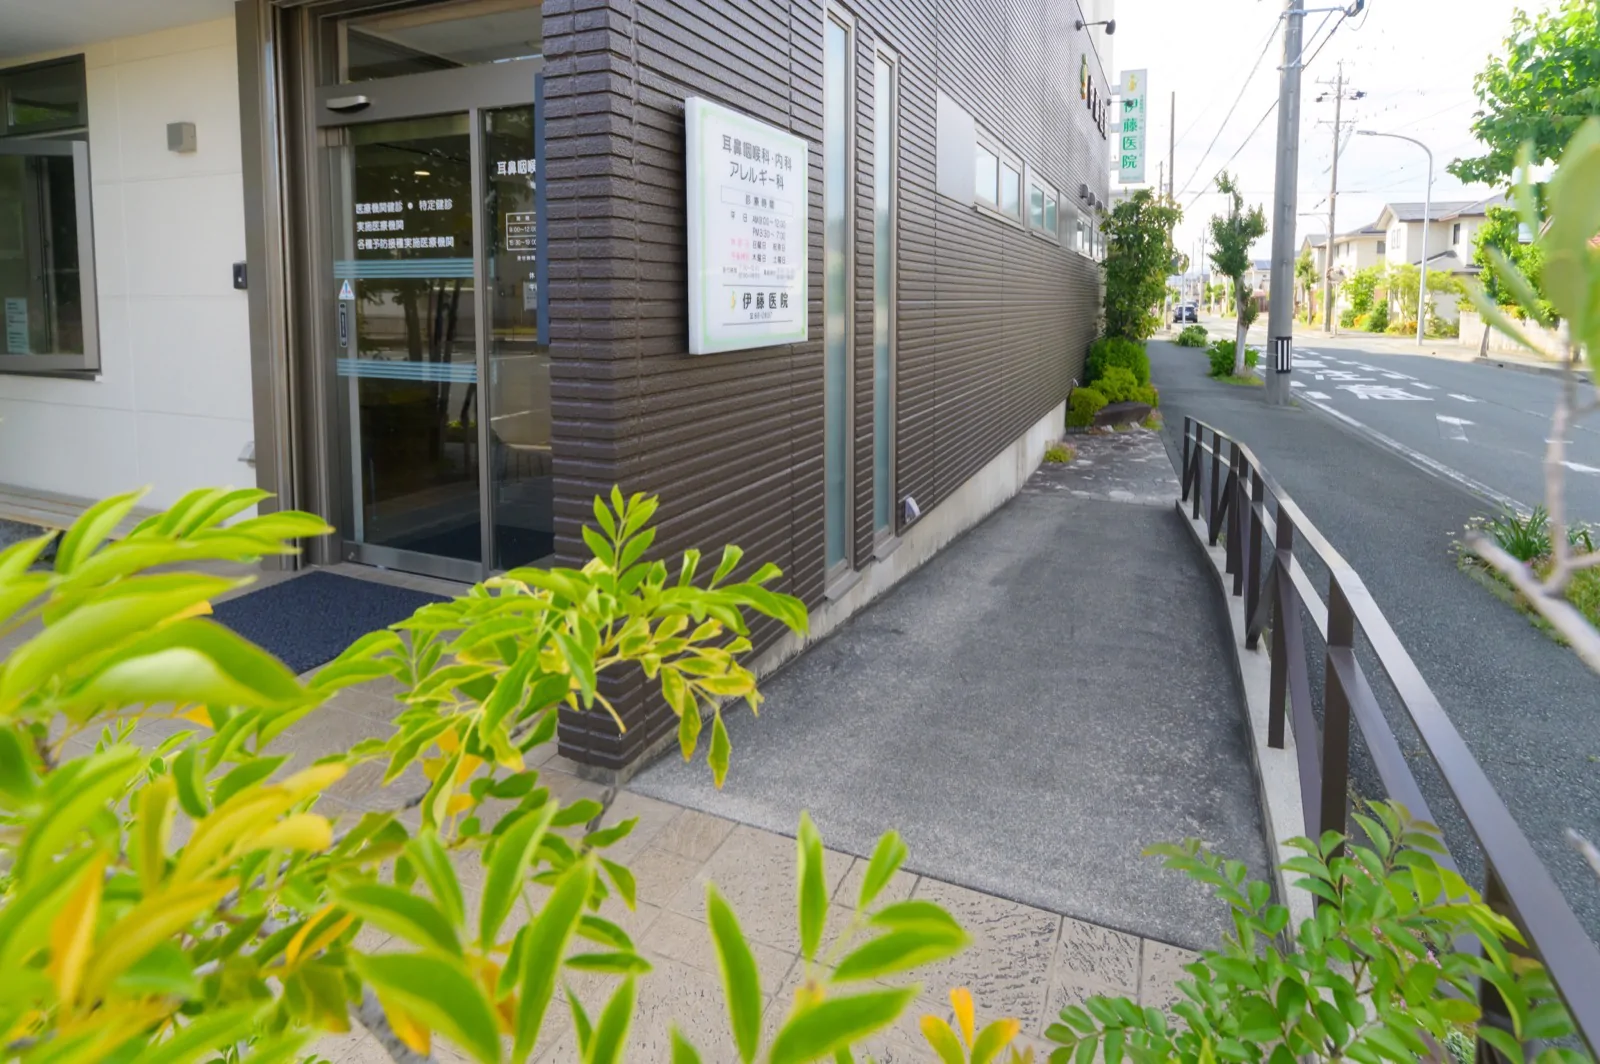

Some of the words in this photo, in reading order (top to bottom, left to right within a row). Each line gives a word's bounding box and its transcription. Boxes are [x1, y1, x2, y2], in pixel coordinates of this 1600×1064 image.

[1122, 98, 1138, 169] 伊藤医院
[722, 134, 792, 172] 耳鼻咽喉科・内科
[730, 161, 784, 191] アレルギー科
[743, 292, 789, 310] 伊藤医院
